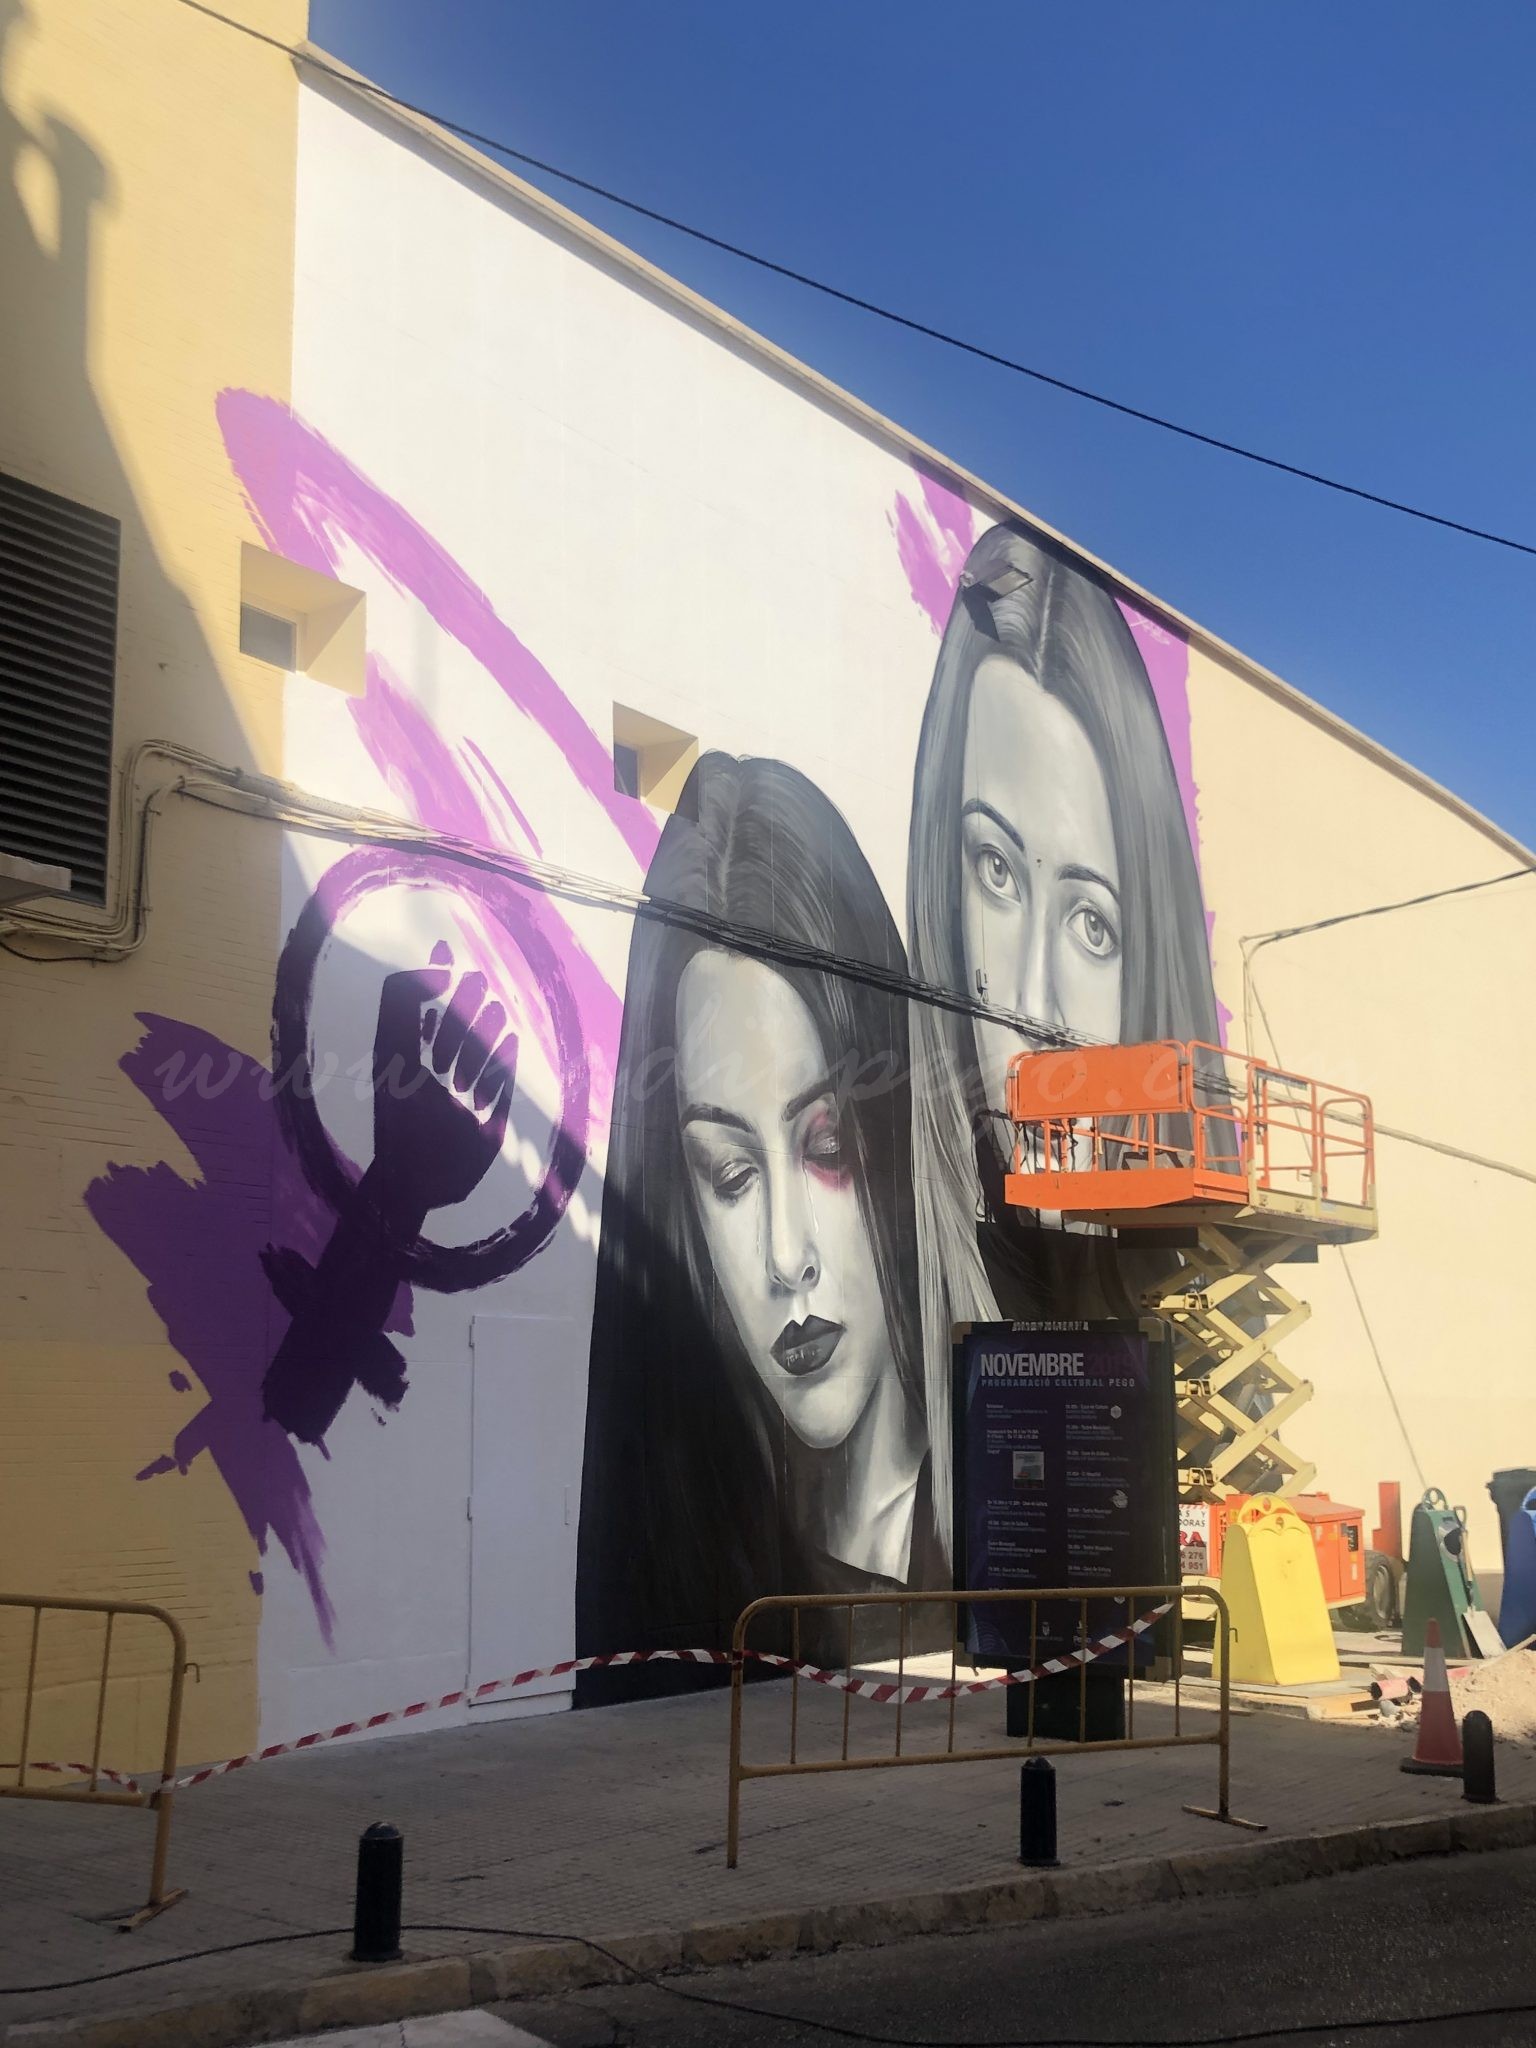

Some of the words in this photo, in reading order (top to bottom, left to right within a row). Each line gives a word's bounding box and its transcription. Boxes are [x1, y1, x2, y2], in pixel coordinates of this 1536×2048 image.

[980, 1353, 1085, 1377] NOVEMBRE
[1088, 1353, 1136, 1376] 2019
[981, 1377, 1050, 1388] PROGRAMACIÓ
[1055, 1378, 1104, 1388] CULTURAL
[1108, 1378, 1136, 1388] PEGO
